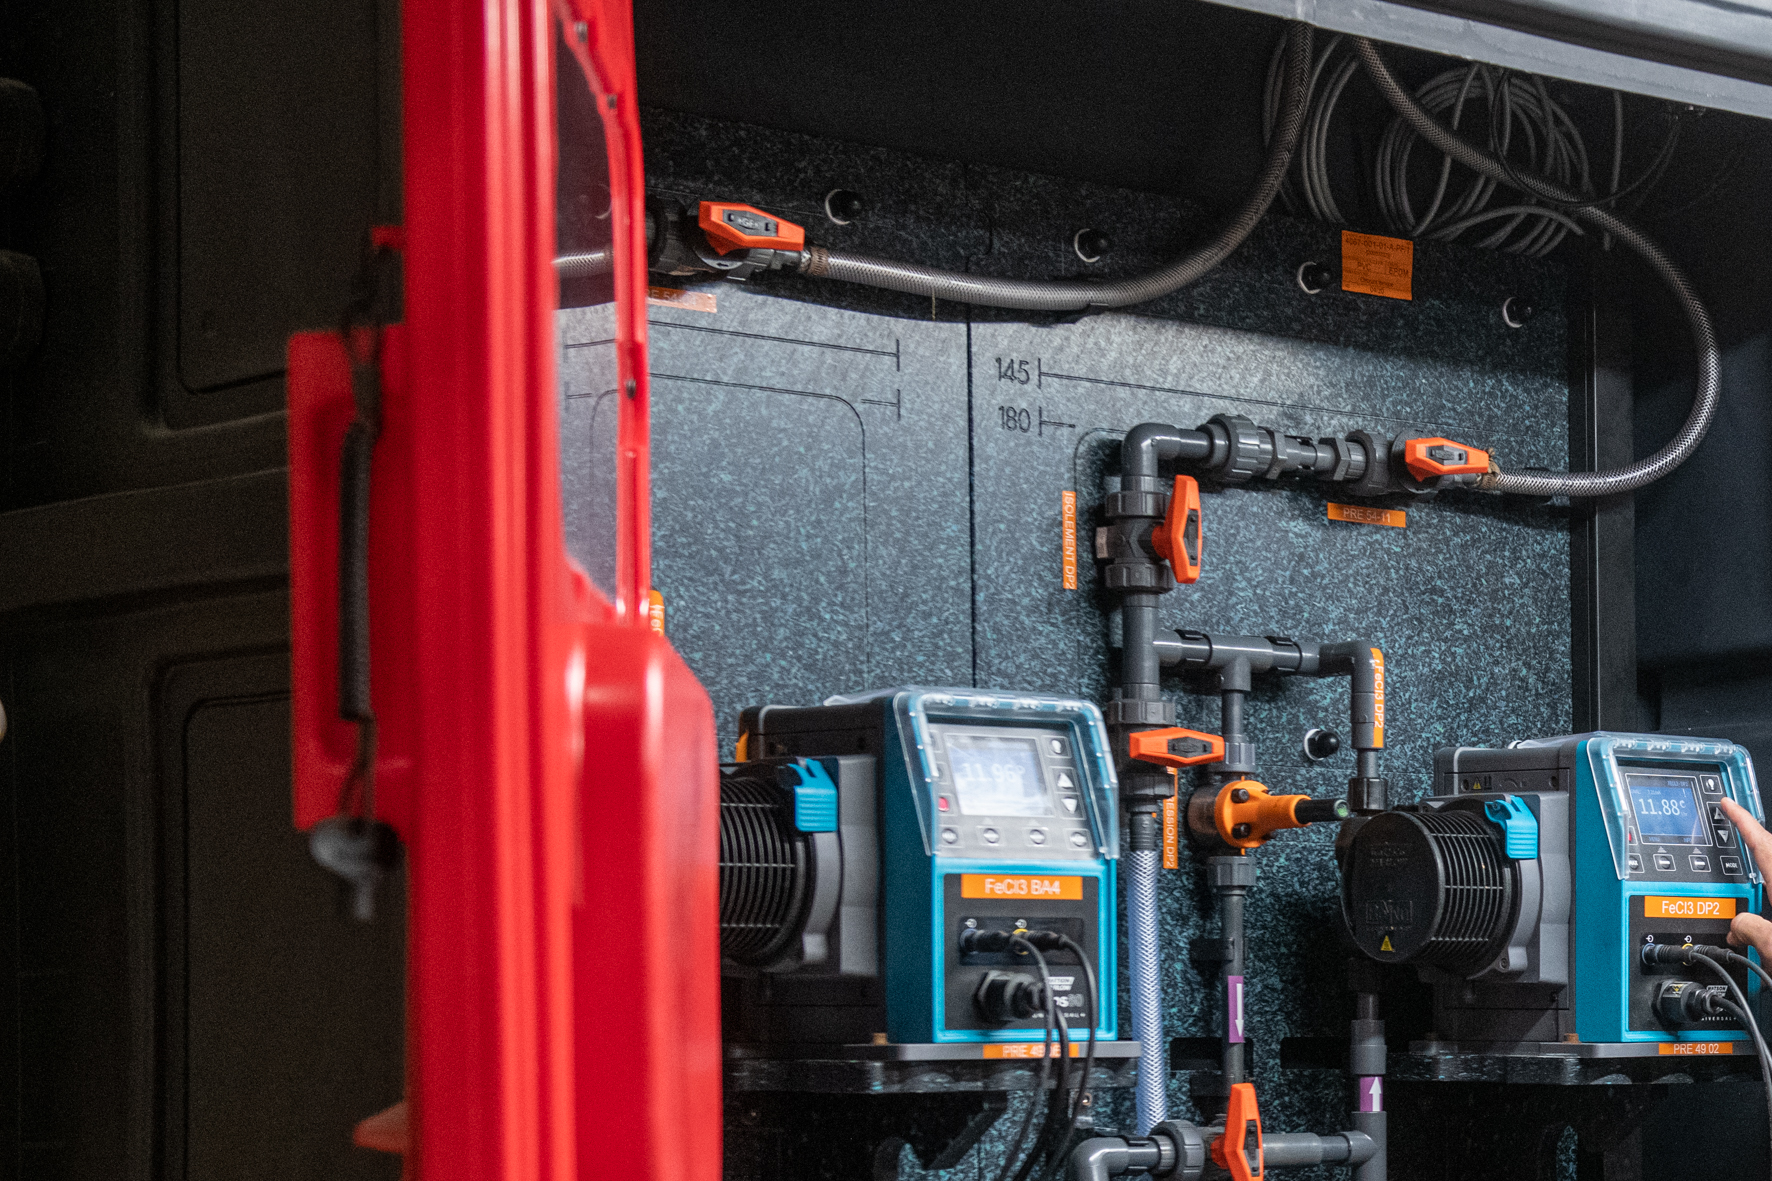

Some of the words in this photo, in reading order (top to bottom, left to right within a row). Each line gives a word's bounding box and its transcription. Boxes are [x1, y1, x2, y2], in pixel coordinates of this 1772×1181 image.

[995, 357, 1030, 385] 145
[998, 405, 1031, 433] 180
[1343, 507, 1364, 521] PRE
[1366, 508, 1391, 523] 54-11
[1064, 492, 1075, 566] ISOLEMENT
[1065, 567, 1075, 590] DP2
[1374, 703, 1384, 729] DP2
[1165, 849, 1174, 868] DP2
[985, 878, 1028, 895] FeCl3
[1030, 880, 1061, 895] BA4
[1661, 900, 1694, 915] FeCl3
[1697, 901, 1720, 915] DP2
[1003, 1045, 1027, 1057] PRE
[1673, 1043, 1693, 1054] PRE
[1695, 1043, 1706, 1054] 49
[1708, 1043, 1720, 1054] 02
